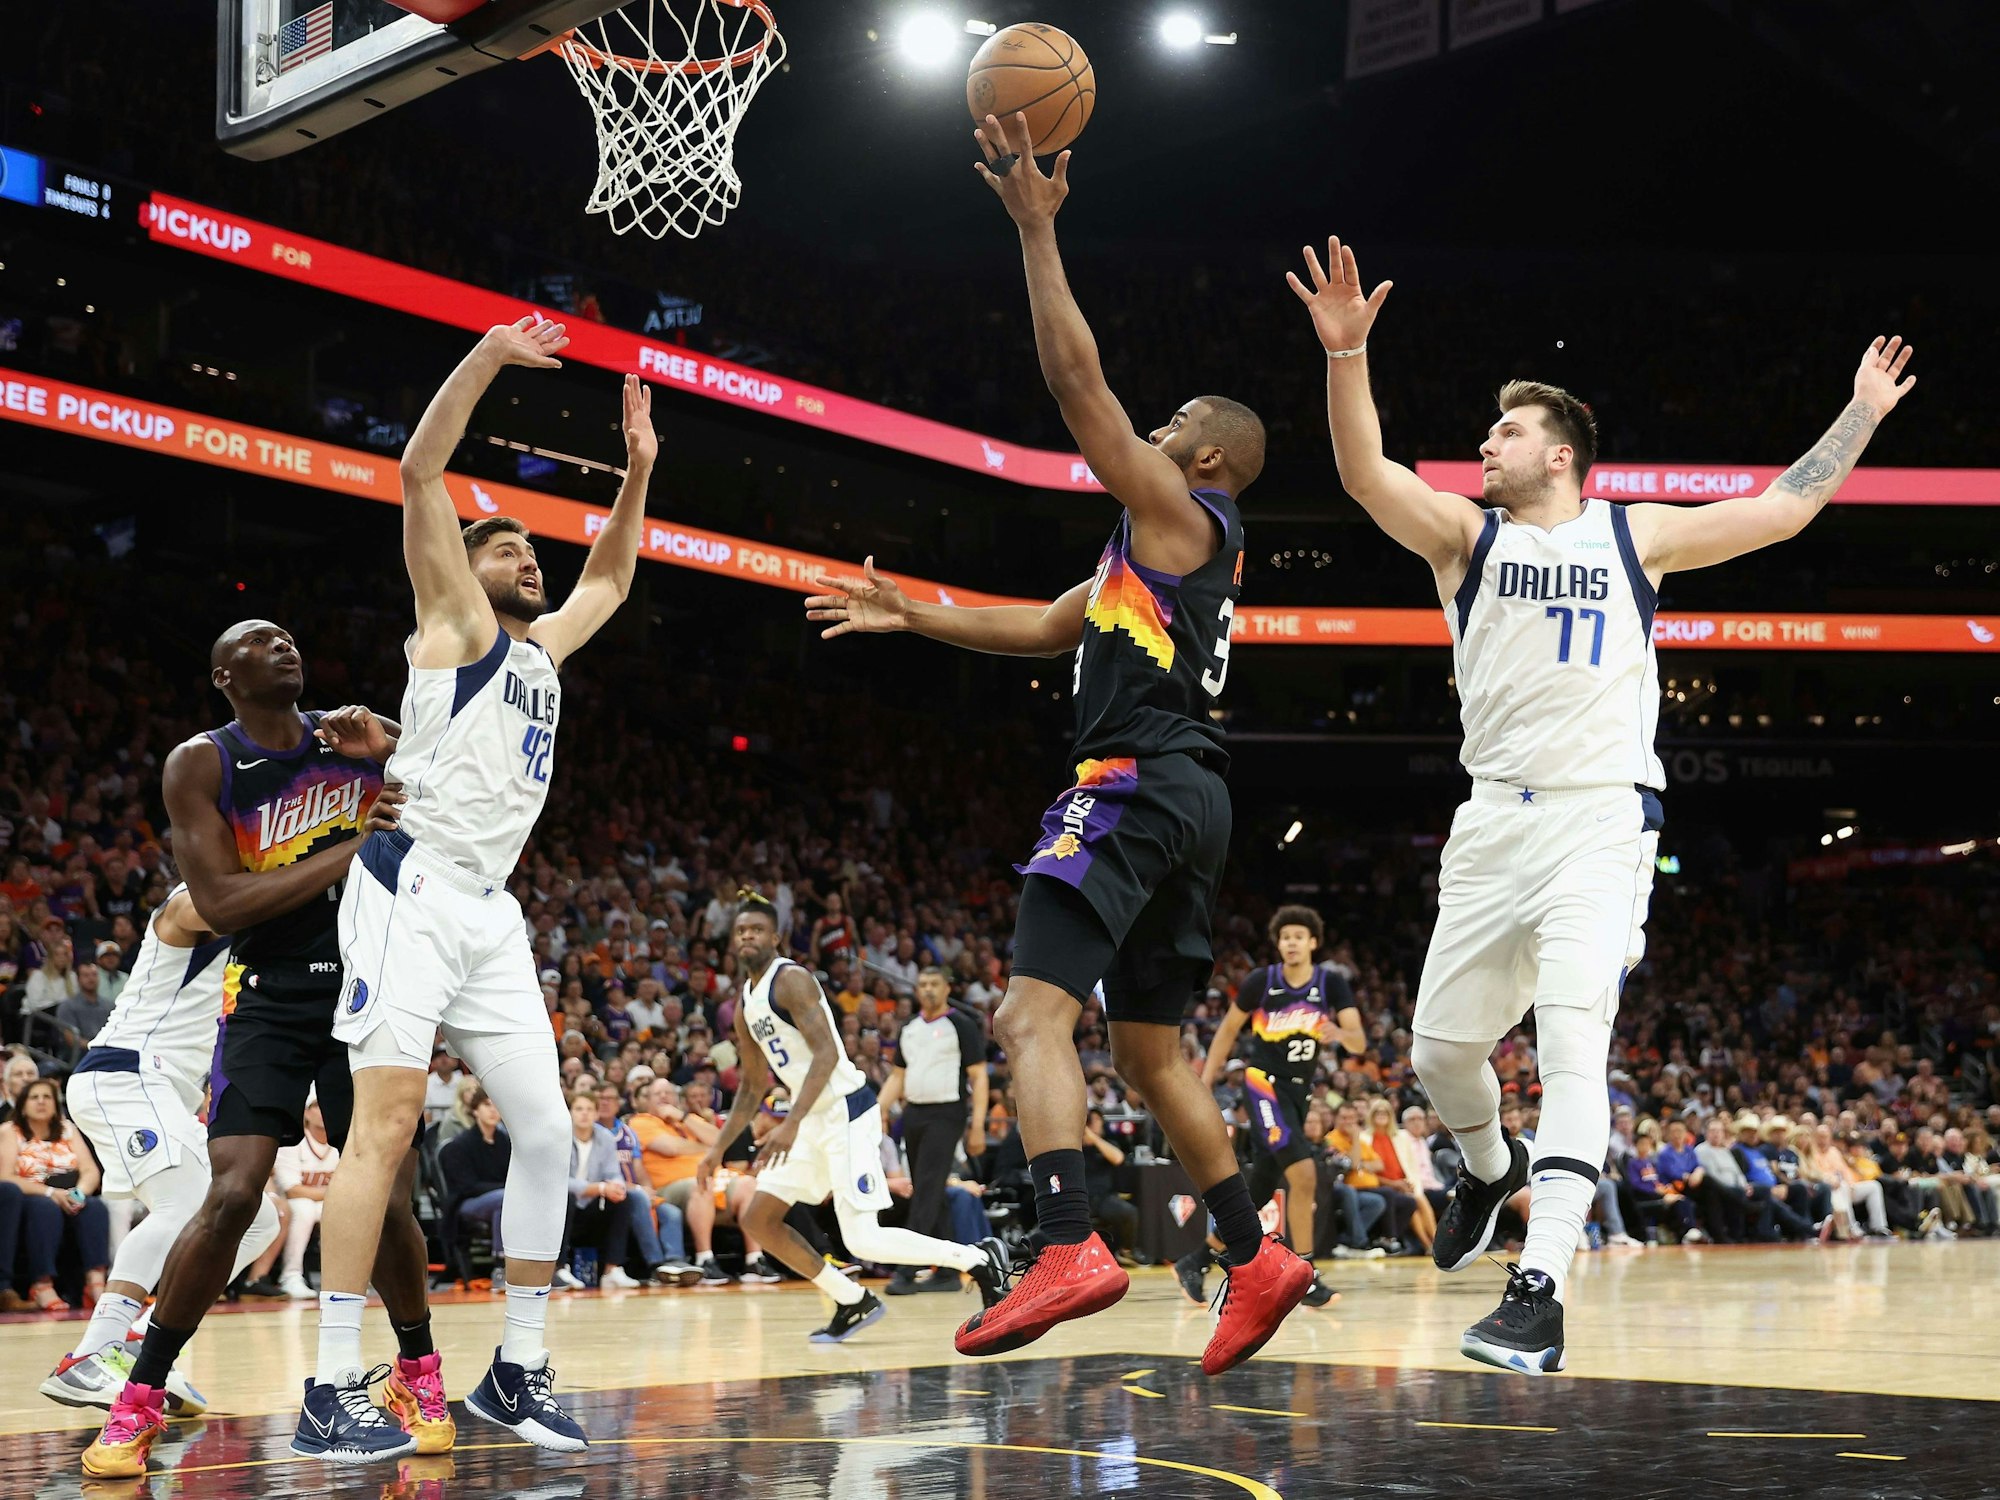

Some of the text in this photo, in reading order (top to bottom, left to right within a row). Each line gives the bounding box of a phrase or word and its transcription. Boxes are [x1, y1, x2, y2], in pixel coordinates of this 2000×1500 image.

[64, 174, 99, 199] FOULS
[45, 187, 99, 218] TIMEOUTS
[272, 243, 312, 269] FOR
[638, 346, 826, 416] FREE PICKUP FOR
[0, 380, 375, 486] EE PICKUP FOR THE WIN!
[1595, 471, 1755, 495] FREE PICKUP
[650, 527, 732, 565] PICKUP
[737, 549, 782, 578] FOR
[786, 558, 826, 585] THE
[1573, 539, 1611, 550] chime
[1498, 562, 1609, 601] DALLAS
[1252, 614, 1301, 636] THE
[1545, 606, 1606, 667] 77
[1722, 620, 1774, 642] FOR
[1779, 621, 1827, 643] THE
[522, 724, 553, 783] 42
[1738, 757, 1835, 778] TEQUILA
[257, 777, 366, 852] Valley
[284, 795, 304, 810] THE
[309, 962, 338, 973] PHX
[768, 1037, 789, 1068] 5
[1287, 1039, 1316, 1062] 23
